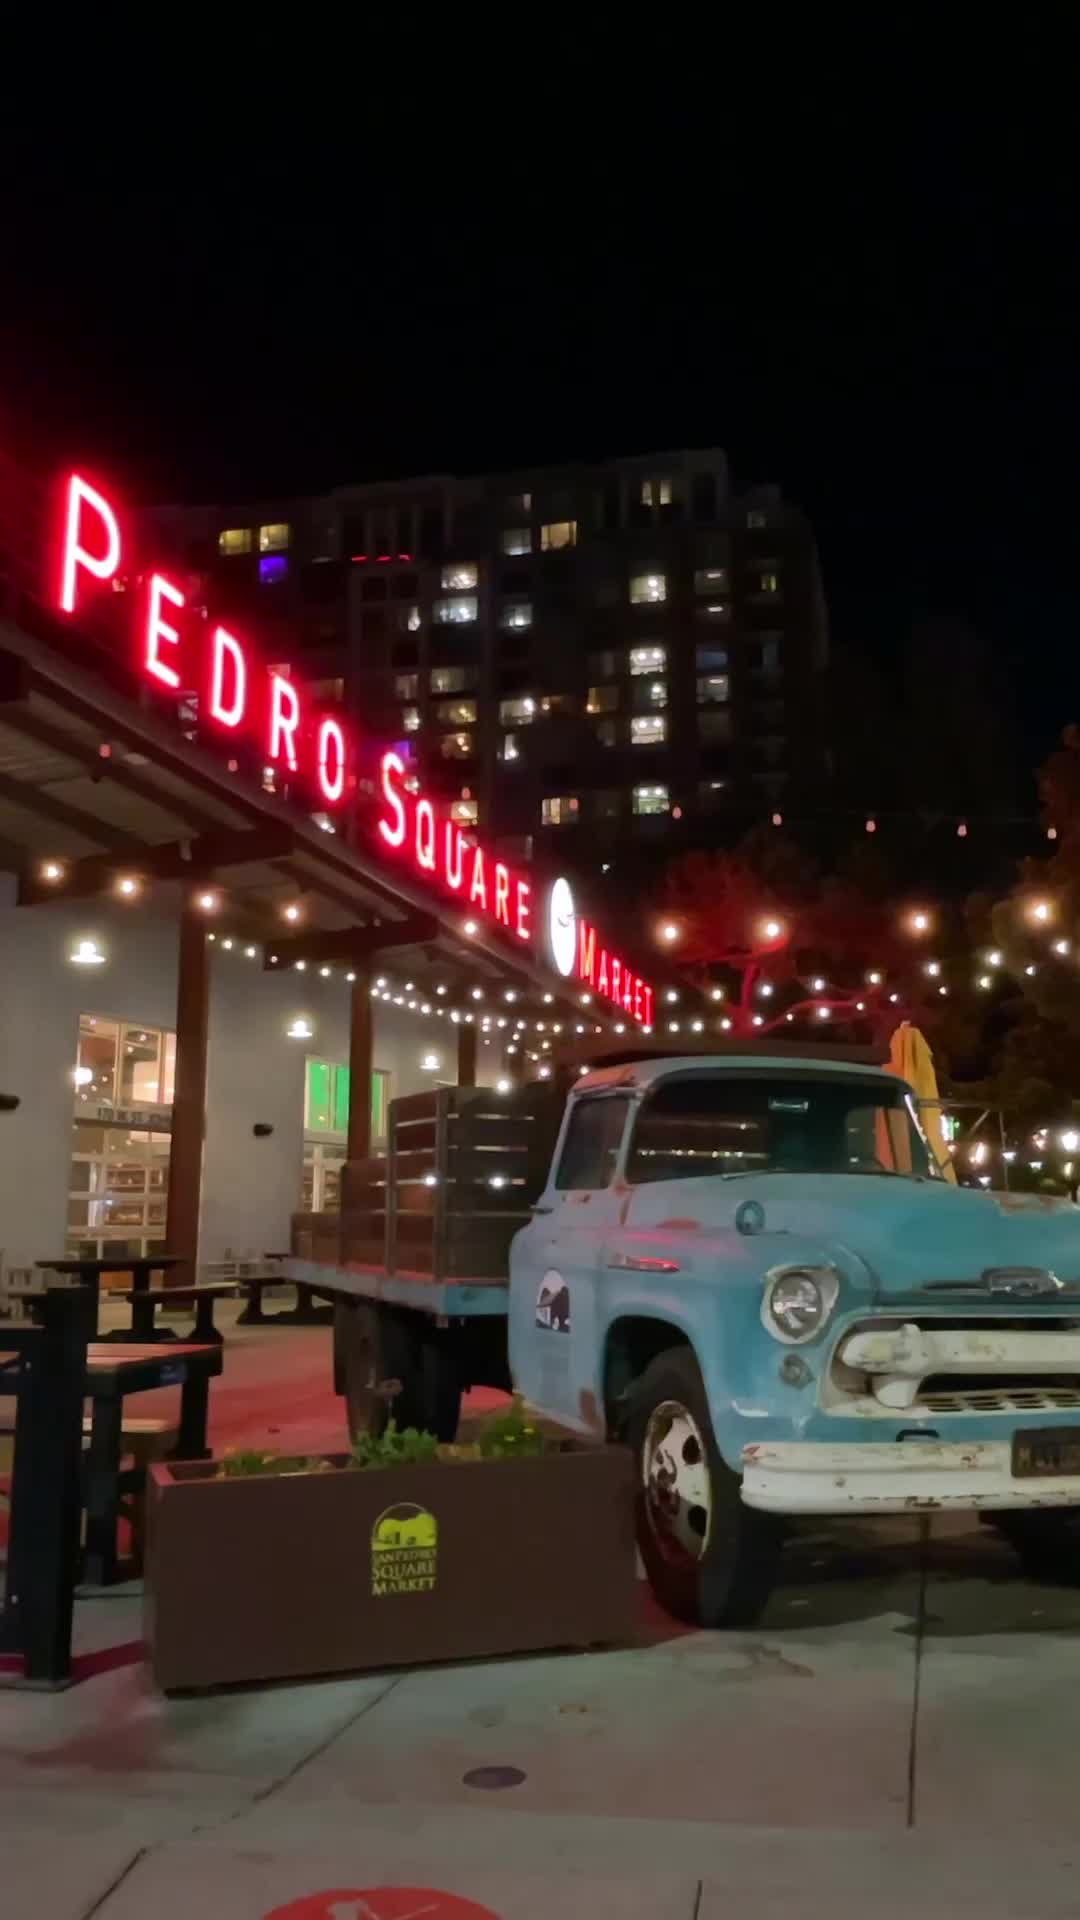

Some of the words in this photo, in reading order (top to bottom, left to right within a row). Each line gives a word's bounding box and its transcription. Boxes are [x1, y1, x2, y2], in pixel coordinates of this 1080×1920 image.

[61, 472, 347, 802] PEDRO
[379, 750, 532, 940] SQUARE
[578, 917, 652, 1026] MARKET
[372, 1576, 436, 1596] MARKET
